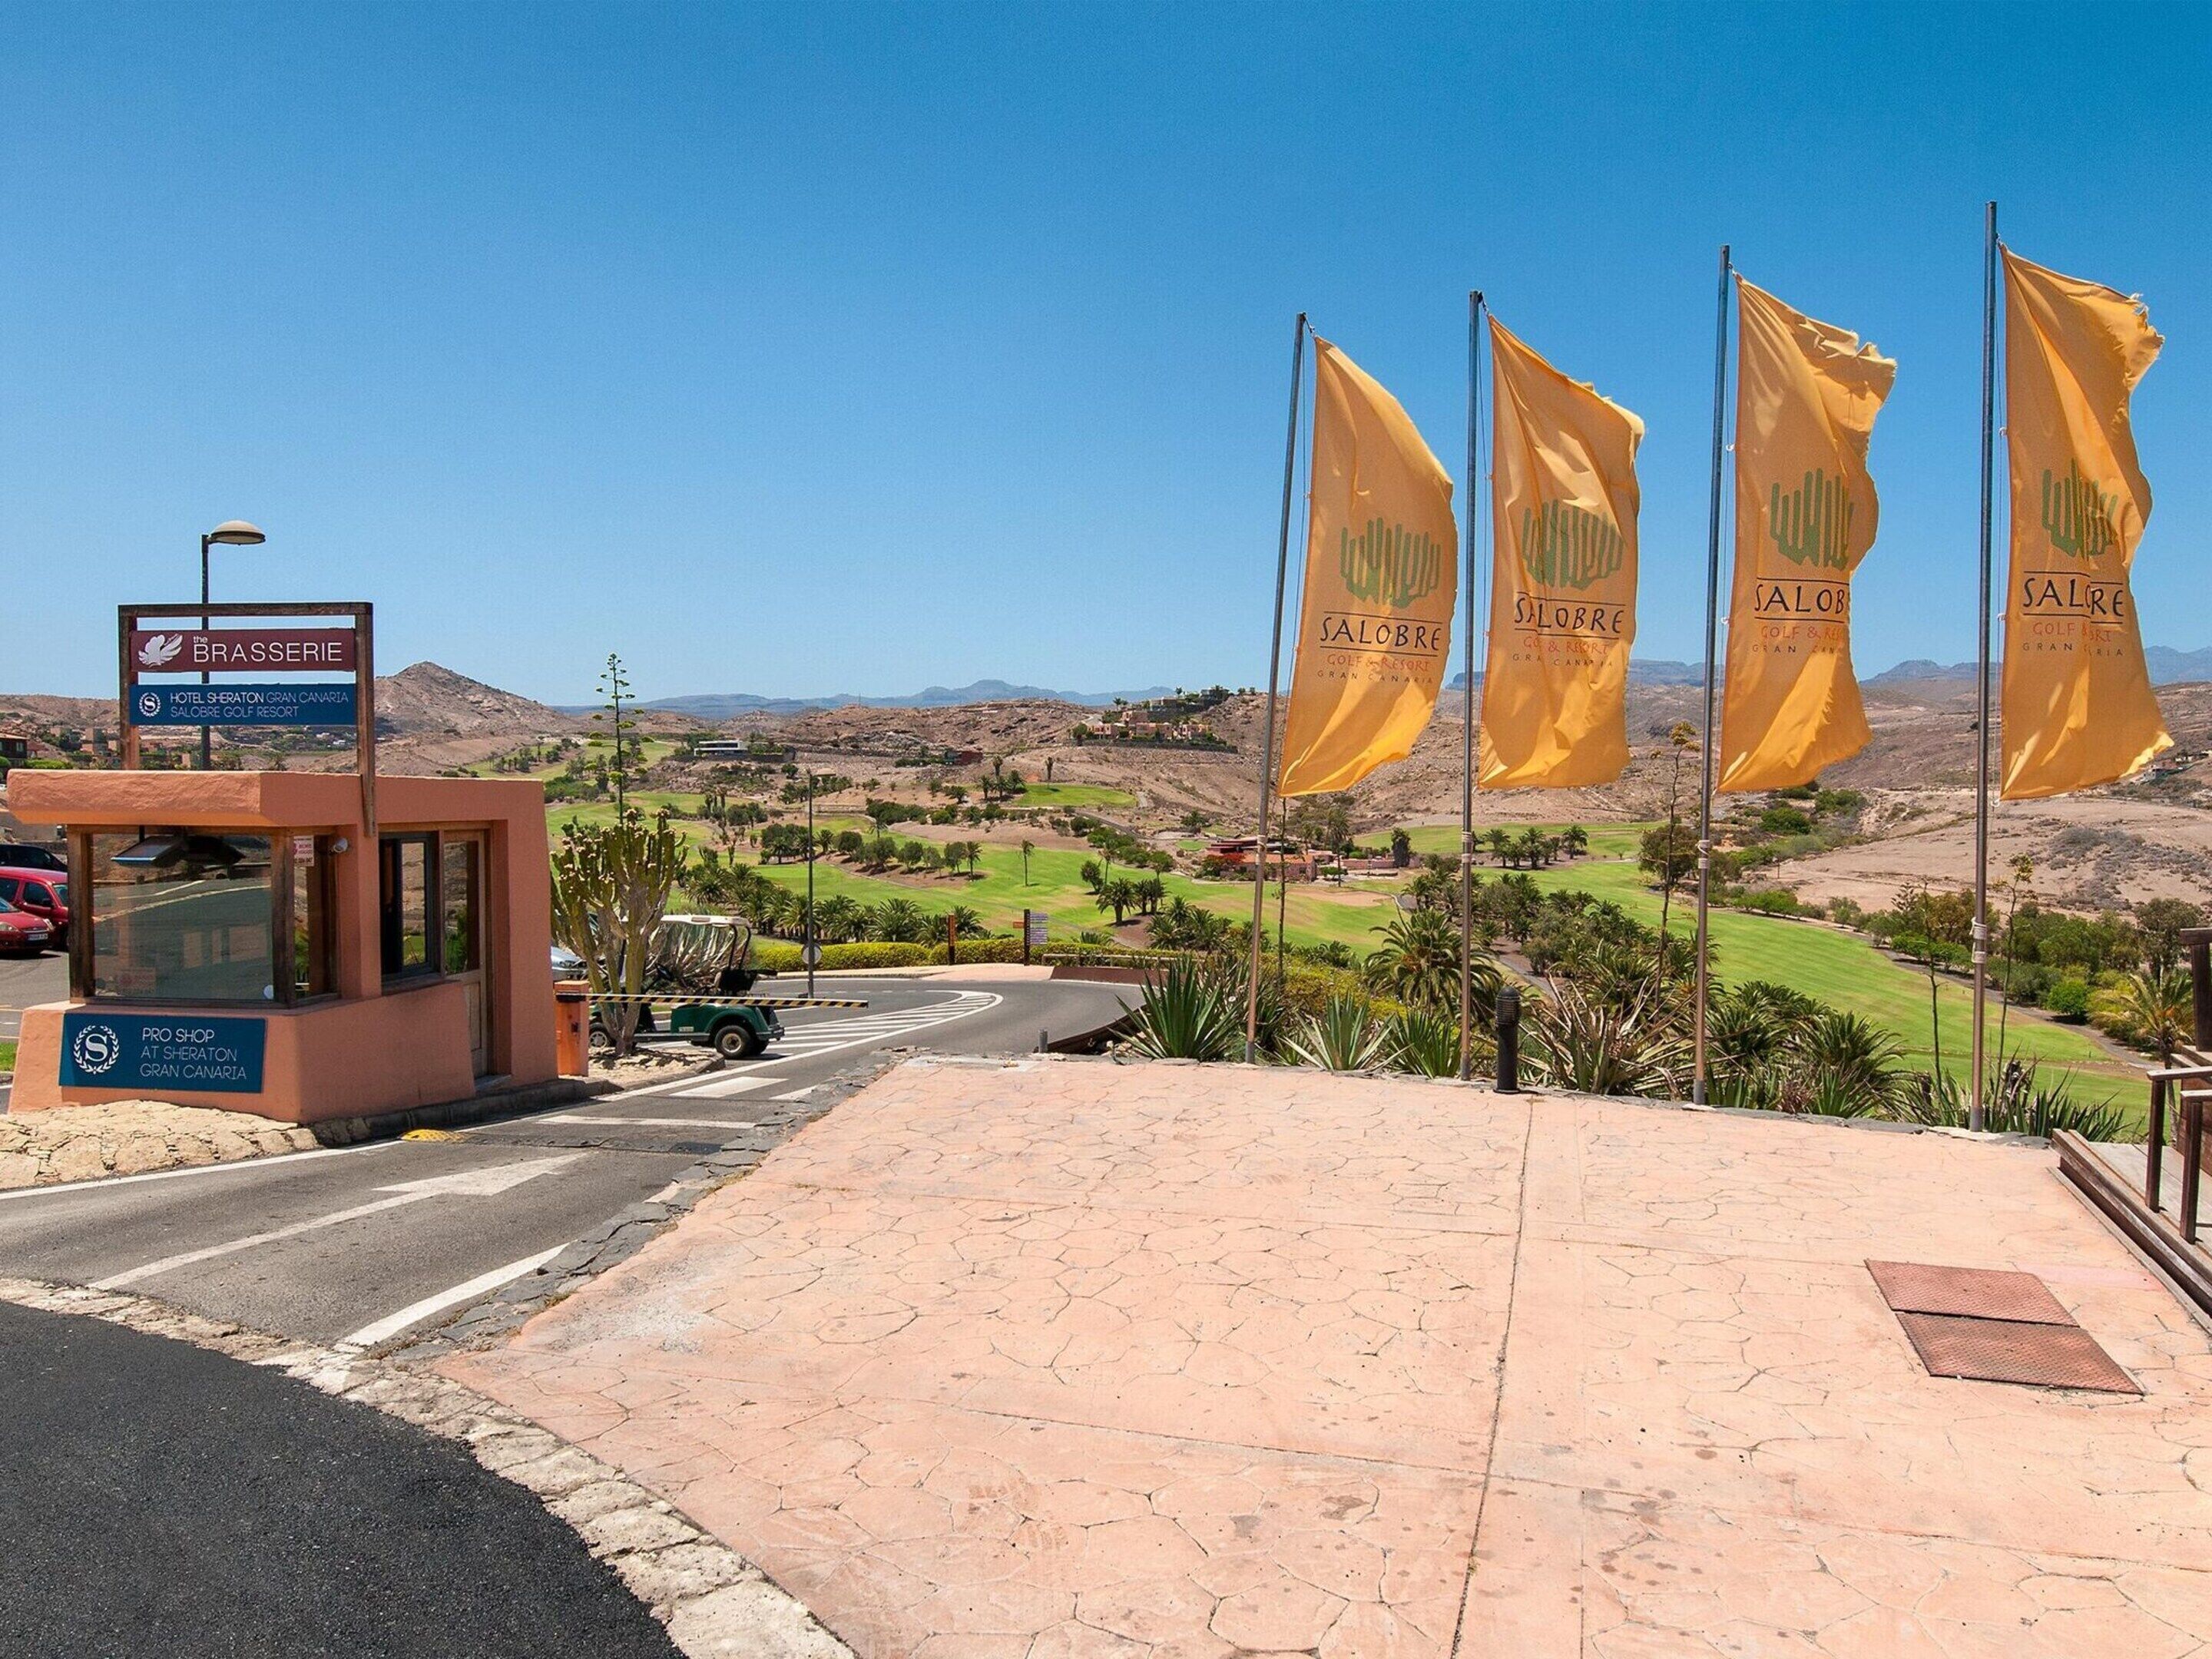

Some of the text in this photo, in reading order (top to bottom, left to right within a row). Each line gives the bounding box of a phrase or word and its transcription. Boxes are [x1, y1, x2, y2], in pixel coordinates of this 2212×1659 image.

[1754, 584, 1845, 614] SALOB
[1515, 598, 1624, 634] SALOBRE
[1320, 617, 1442, 651] SALOBRE
[1761, 625, 1800, 639] GOLF
[1807, 626, 1820, 639] &
[2033, 623, 2075, 635] GOLF
[193, 634, 208, 644] the
[194, 641, 343, 663] BRASSERIE
[1548, 641, 1561, 654] &
[2022, 643, 2073, 651] GRAN
[1327, 654, 1364, 666] GOLF
[1380, 656, 1430, 673] RESORT
[1317, 670, 1433, 684] GRAN CANARIA
[170, 691, 349, 704] HOTEL SHERATON GRAN CANARIA
[171, 706, 299, 718] SALOBRE GOLF RESORT
[142, 1028, 215, 1043] PRO SHOP
[141, 1045, 237, 1061] AT SHERATON
[139, 1063, 247, 1080] GRAN CANARIA
